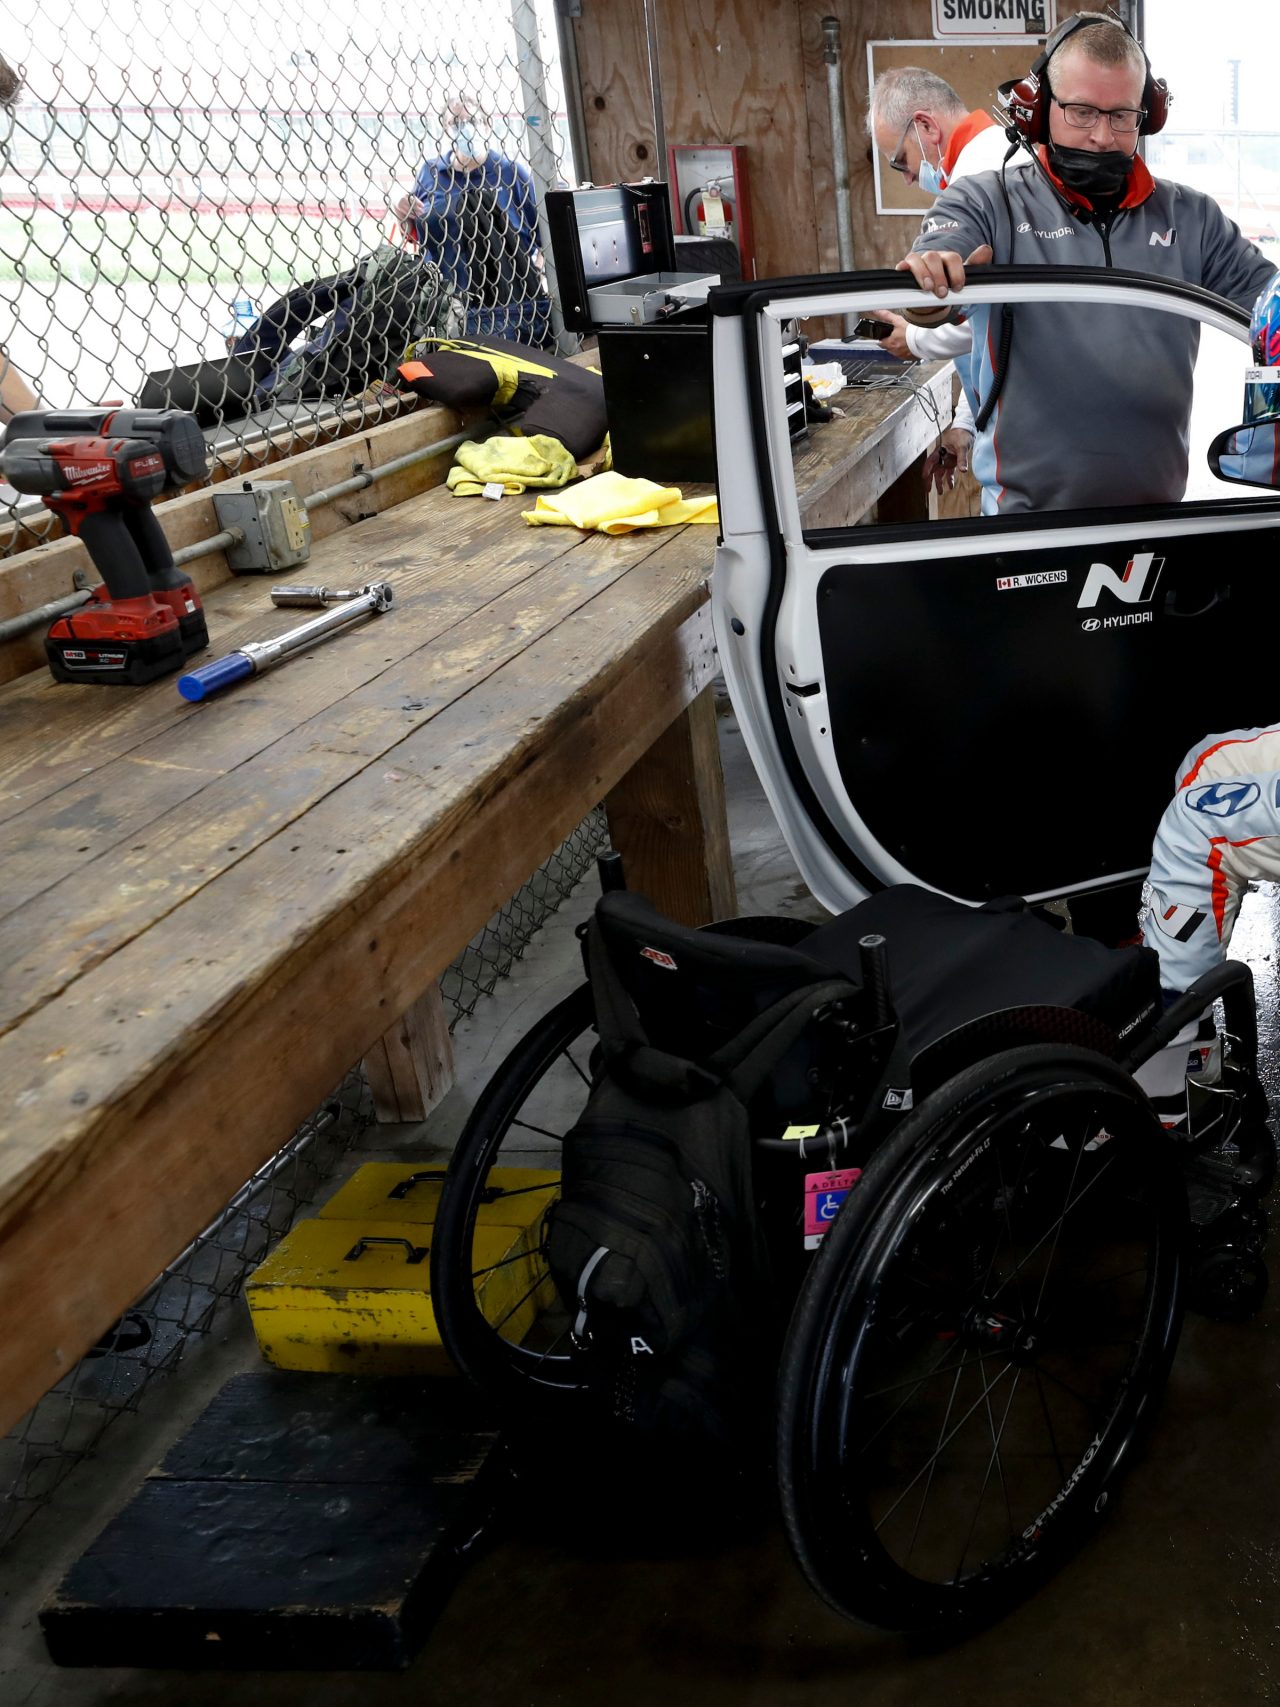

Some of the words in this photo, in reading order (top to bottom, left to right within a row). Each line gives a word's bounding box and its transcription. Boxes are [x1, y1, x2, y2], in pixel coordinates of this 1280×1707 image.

[944, 0, 1045, 19] SMOKING
[134, 457, 160, 469] FUEL
[63, 463, 112, 481] Milwaukee
[1013, 578, 1022, 587] R.
[1025, 571, 1066, 585] WICKENS
[1103, 612, 1153, 629] HYUNDAI
[940, 1180, 953, 1195] The
